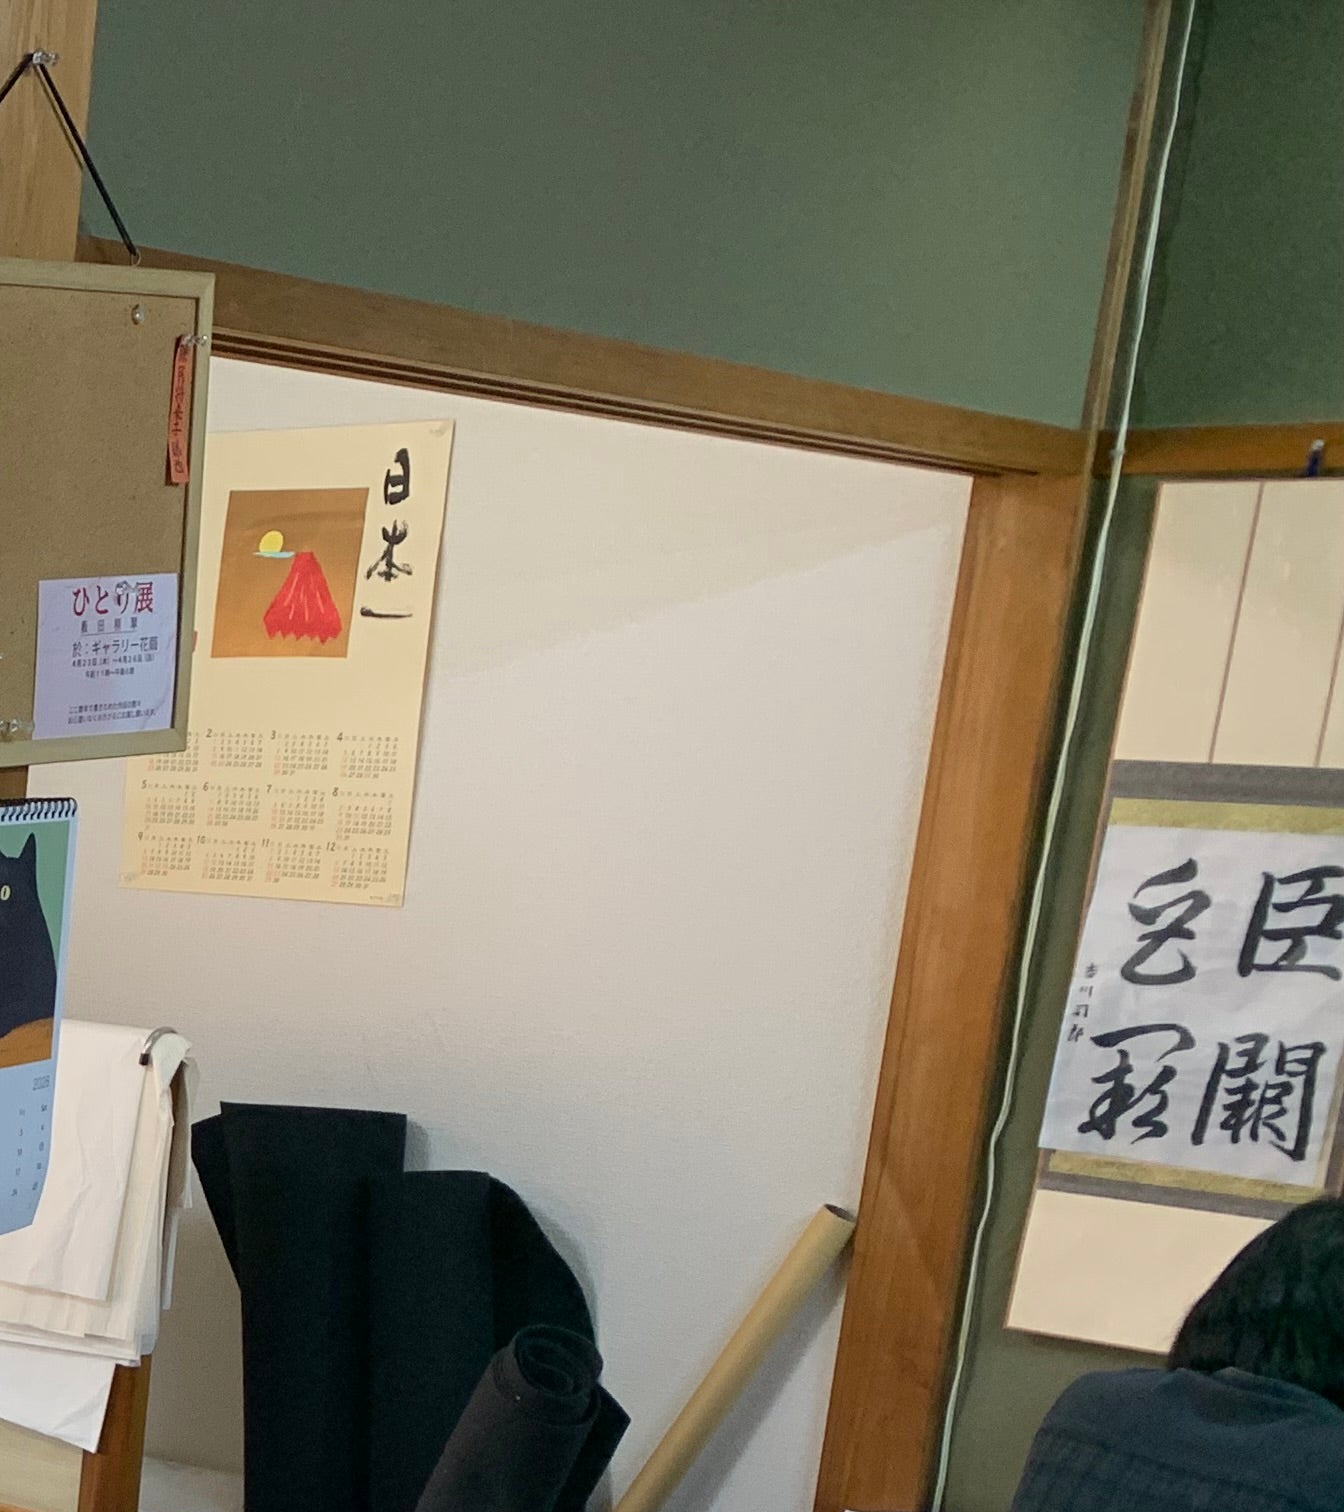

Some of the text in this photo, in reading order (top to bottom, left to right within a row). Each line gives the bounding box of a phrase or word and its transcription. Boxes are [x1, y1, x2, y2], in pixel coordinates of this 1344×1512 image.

[359, 447, 414, 619] 日本一
[72, 581, 154, 617] ひとり展
[205, 728, 212, 738] 2
[270, 730, 276, 740] 3
[336, 732, 344, 742] 4
[141, 780, 147, 790] 5
[202, 782, 209, 792] 6
[266, 784, 272, 793] 7
[196, 835, 206, 844] 10
[262, 838, 270, 848] 11
[326, 841, 336, 852] 12
